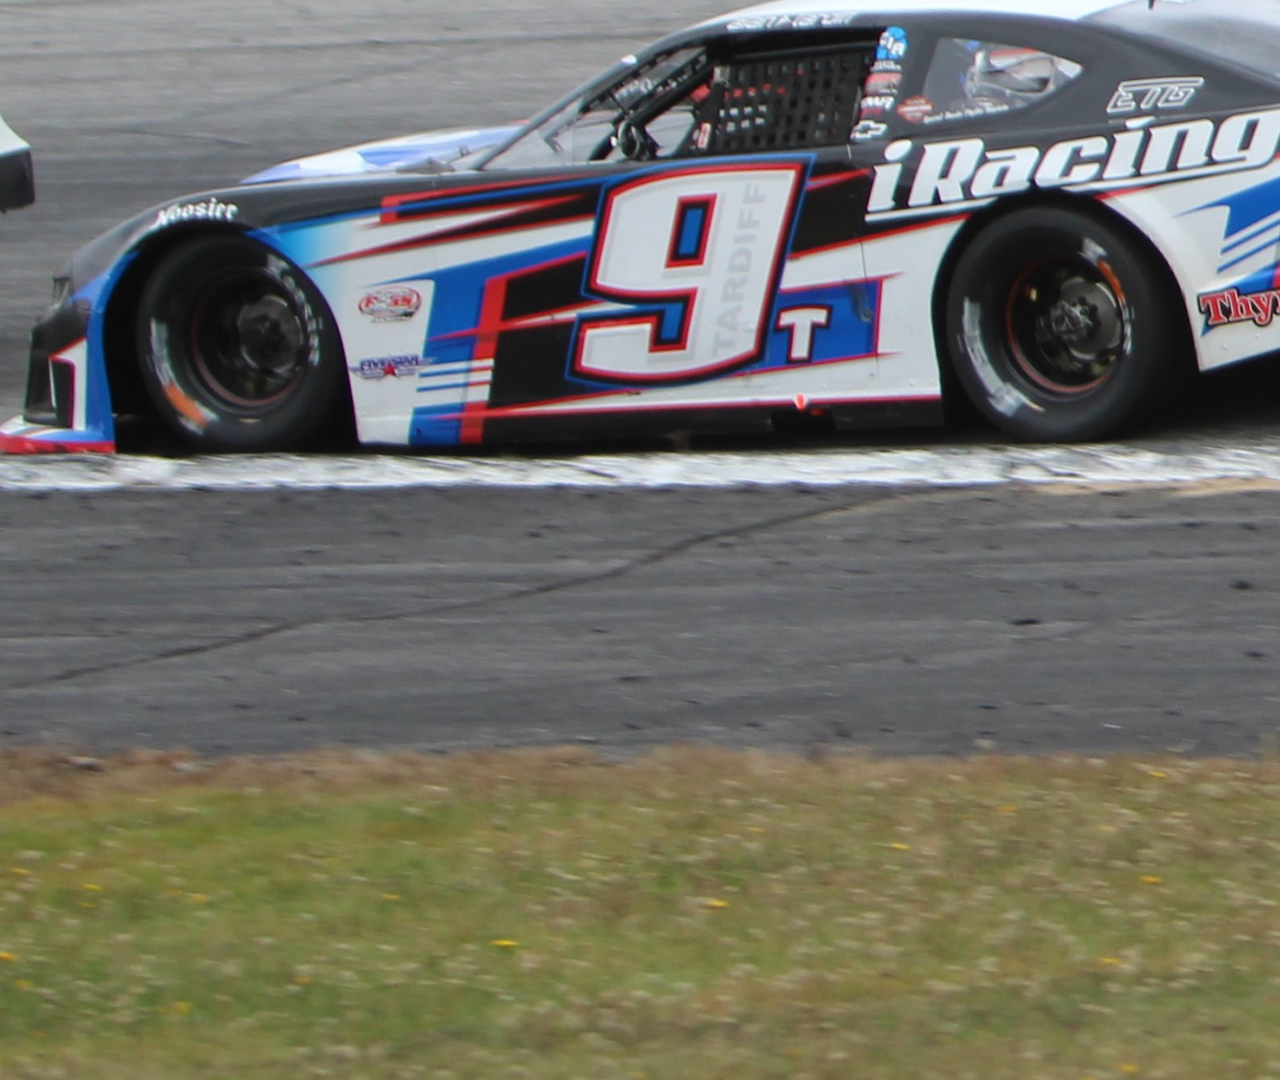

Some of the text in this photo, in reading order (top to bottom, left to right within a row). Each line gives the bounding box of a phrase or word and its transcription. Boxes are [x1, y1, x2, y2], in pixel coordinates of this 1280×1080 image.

[570, 160, 806, 384] 9
[713, 182, 767, 357] TARDIFF
[777, 306, 832, 365] T
